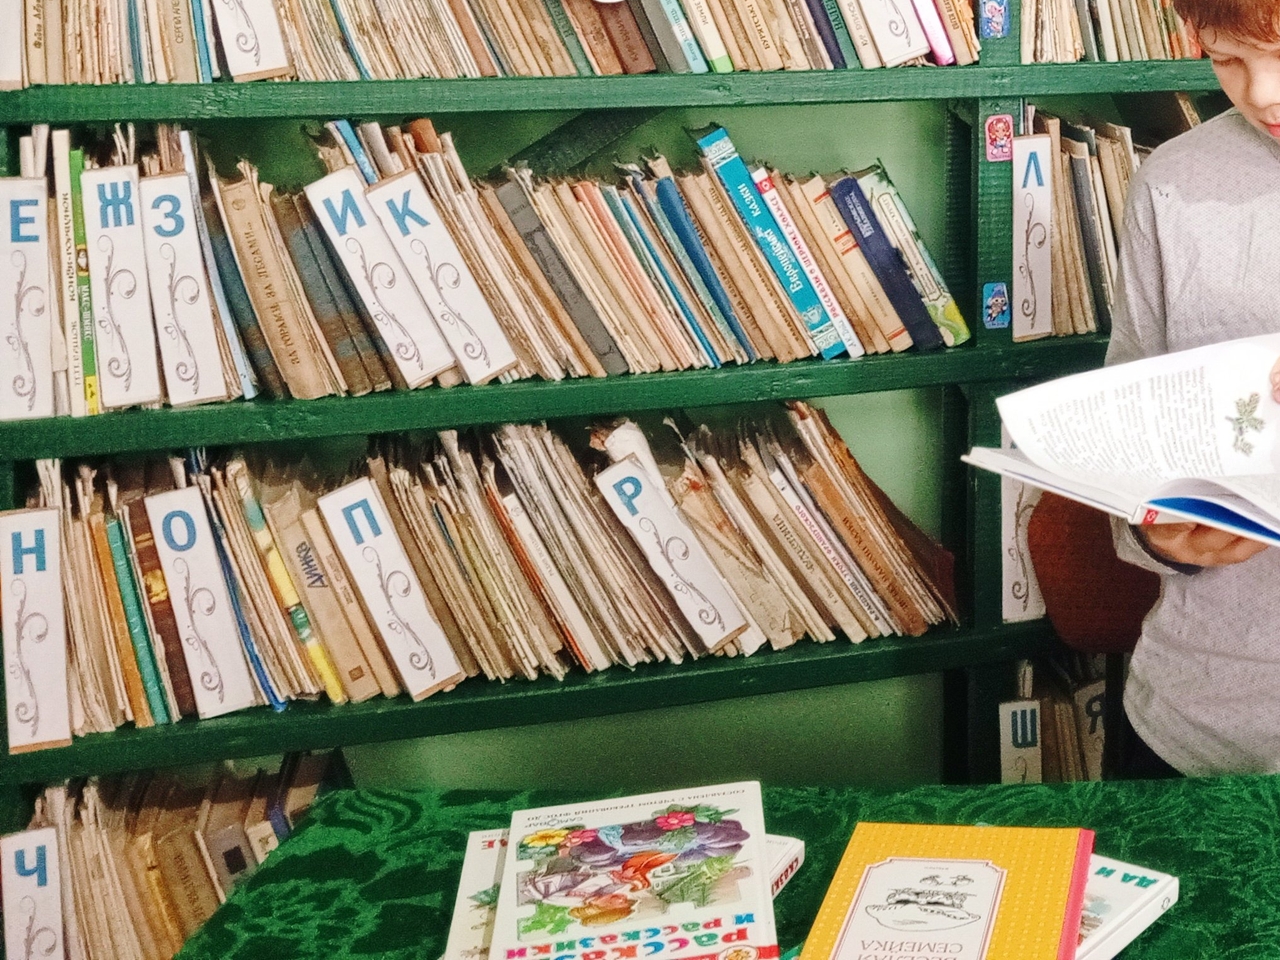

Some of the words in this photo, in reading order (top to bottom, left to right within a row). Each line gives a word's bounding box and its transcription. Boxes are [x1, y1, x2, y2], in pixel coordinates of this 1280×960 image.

[172, 16, 183, 43] СЕРГІЙ
[693, 0, 709, 25] ЗЕМЛИ
[746, 3, 770, 50] БУРЯТСЬКІ
[10, 198, 39, 244] Е
[97, 180, 134, 229] Ж
[151, 194, 185, 239] З
[321, 188, 365, 237] И
[386, 189, 429, 237] К
[768, 195, 791, 229] ХОЛМСЕ
[786, 229, 812, 268] ШЕРЛОКЕ
[262, 282, 277, 299] ЗА
[287, 349, 300, 365] ЗА
[611, 475, 643, 517] Р
[161, 509, 198, 553] О
[341, 497, 384, 545] П
[793, 504, 833, 555] ФРАНЦУЗСКОГО
[840, 516, 864, 544] КАЗКИ
[12, 529, 46, 575] Н
[830, 555, 849, 577] УРОКИ
[1010, 711, 1038, 749] Ш
[14, 844, 48, 887] Ч
[859, 940, 963, 955] СЕМЕЙКА
